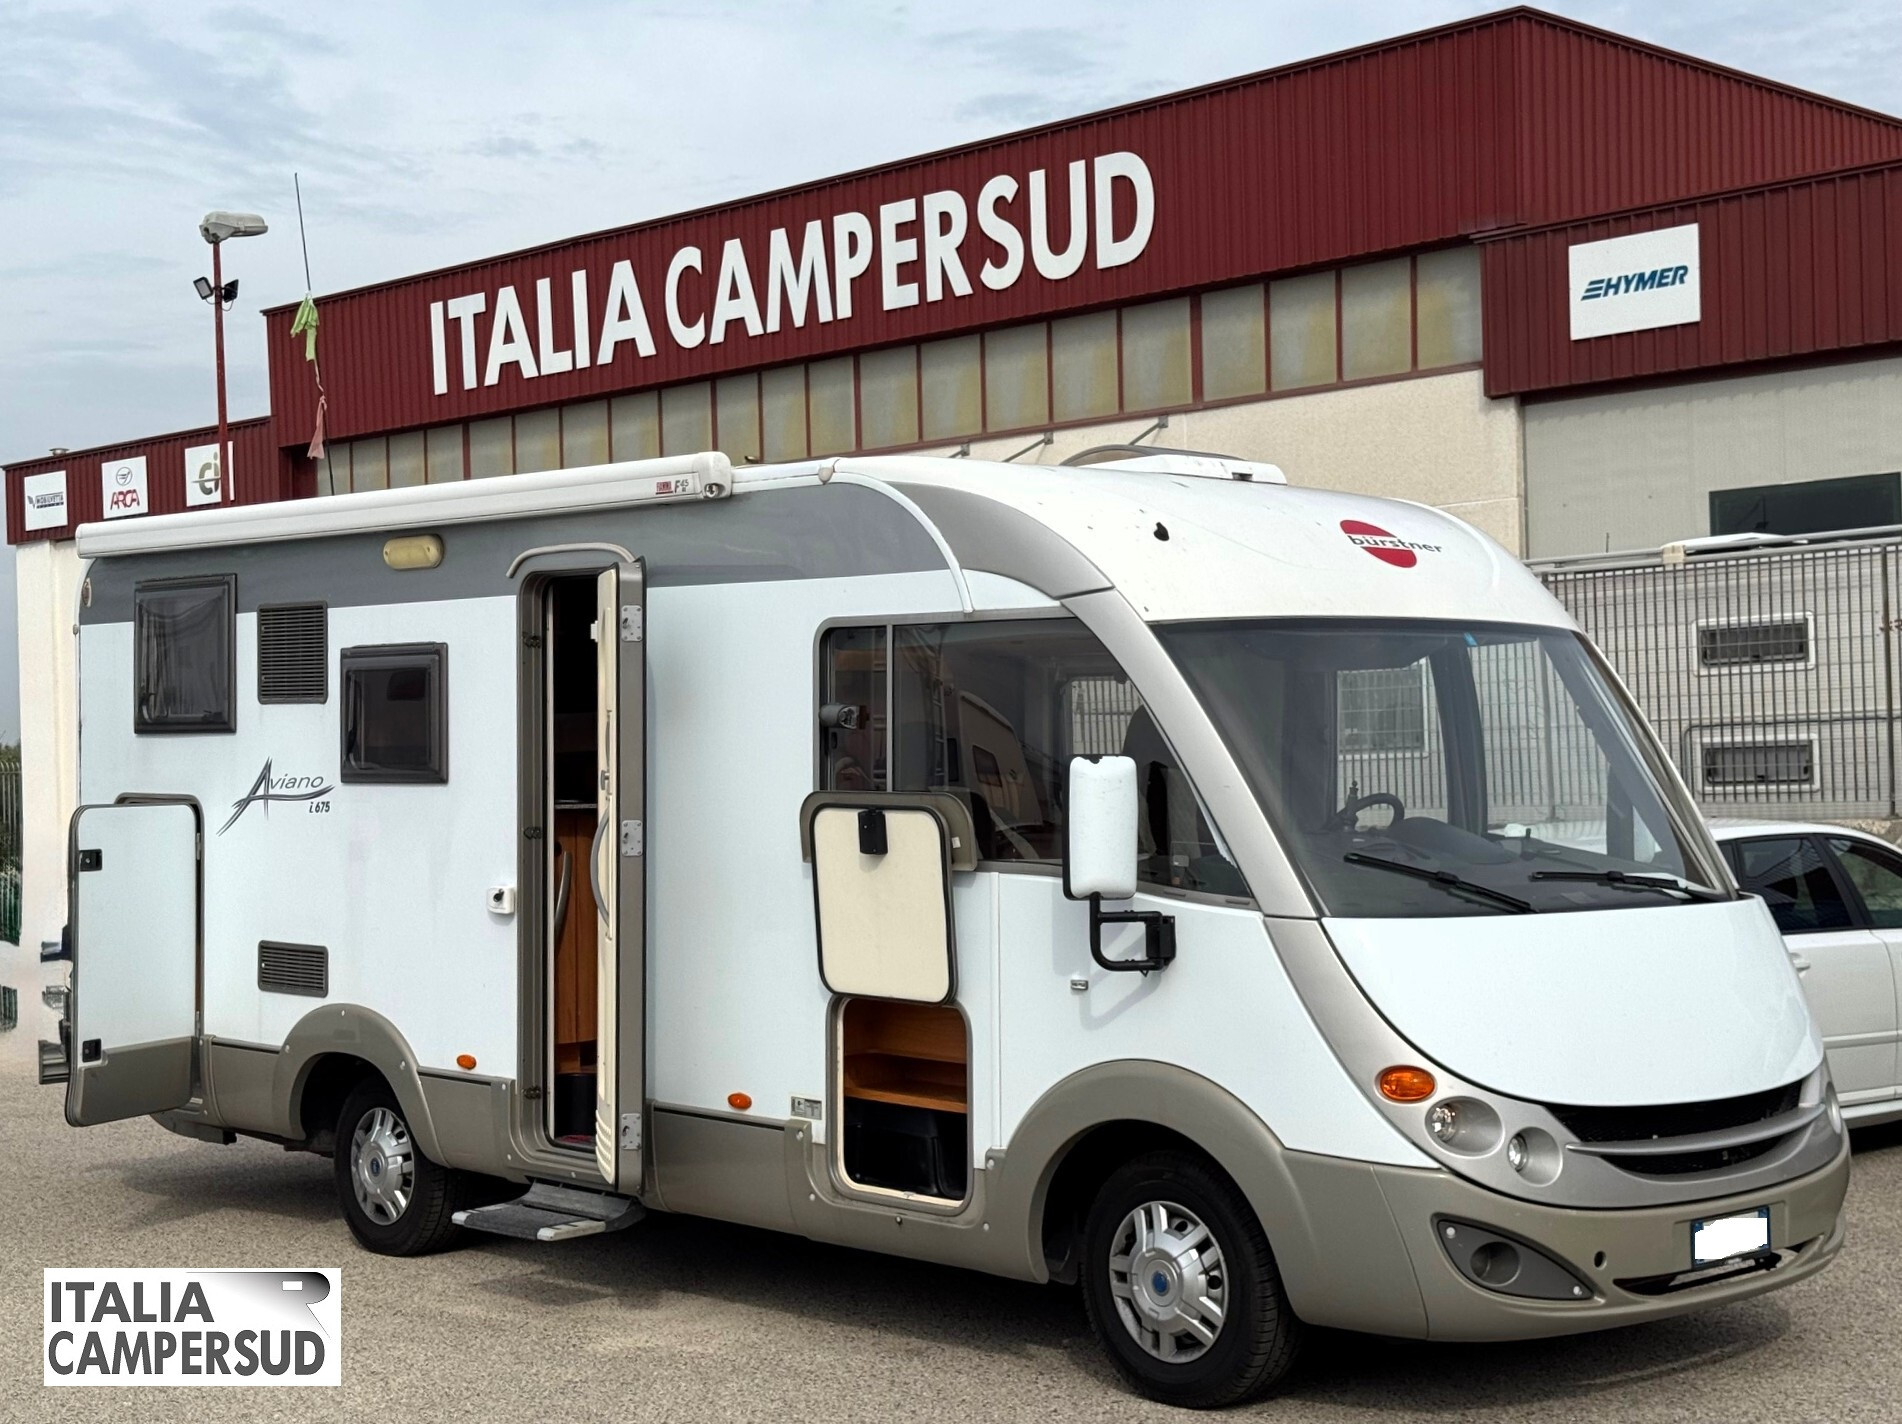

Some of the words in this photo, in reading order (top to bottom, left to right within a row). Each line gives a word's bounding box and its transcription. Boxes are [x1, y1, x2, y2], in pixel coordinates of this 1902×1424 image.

[430, 260, 657, 395] ITALIA
[665, 151, 1155, 350] CAMPERSUD
[1602, 264, 1689, 298] HYMER
[110, 489, 140, 510] ARCA
[1347, 534, 1444, 554] bürstner
[218, 757, 333, 834] Aviano
